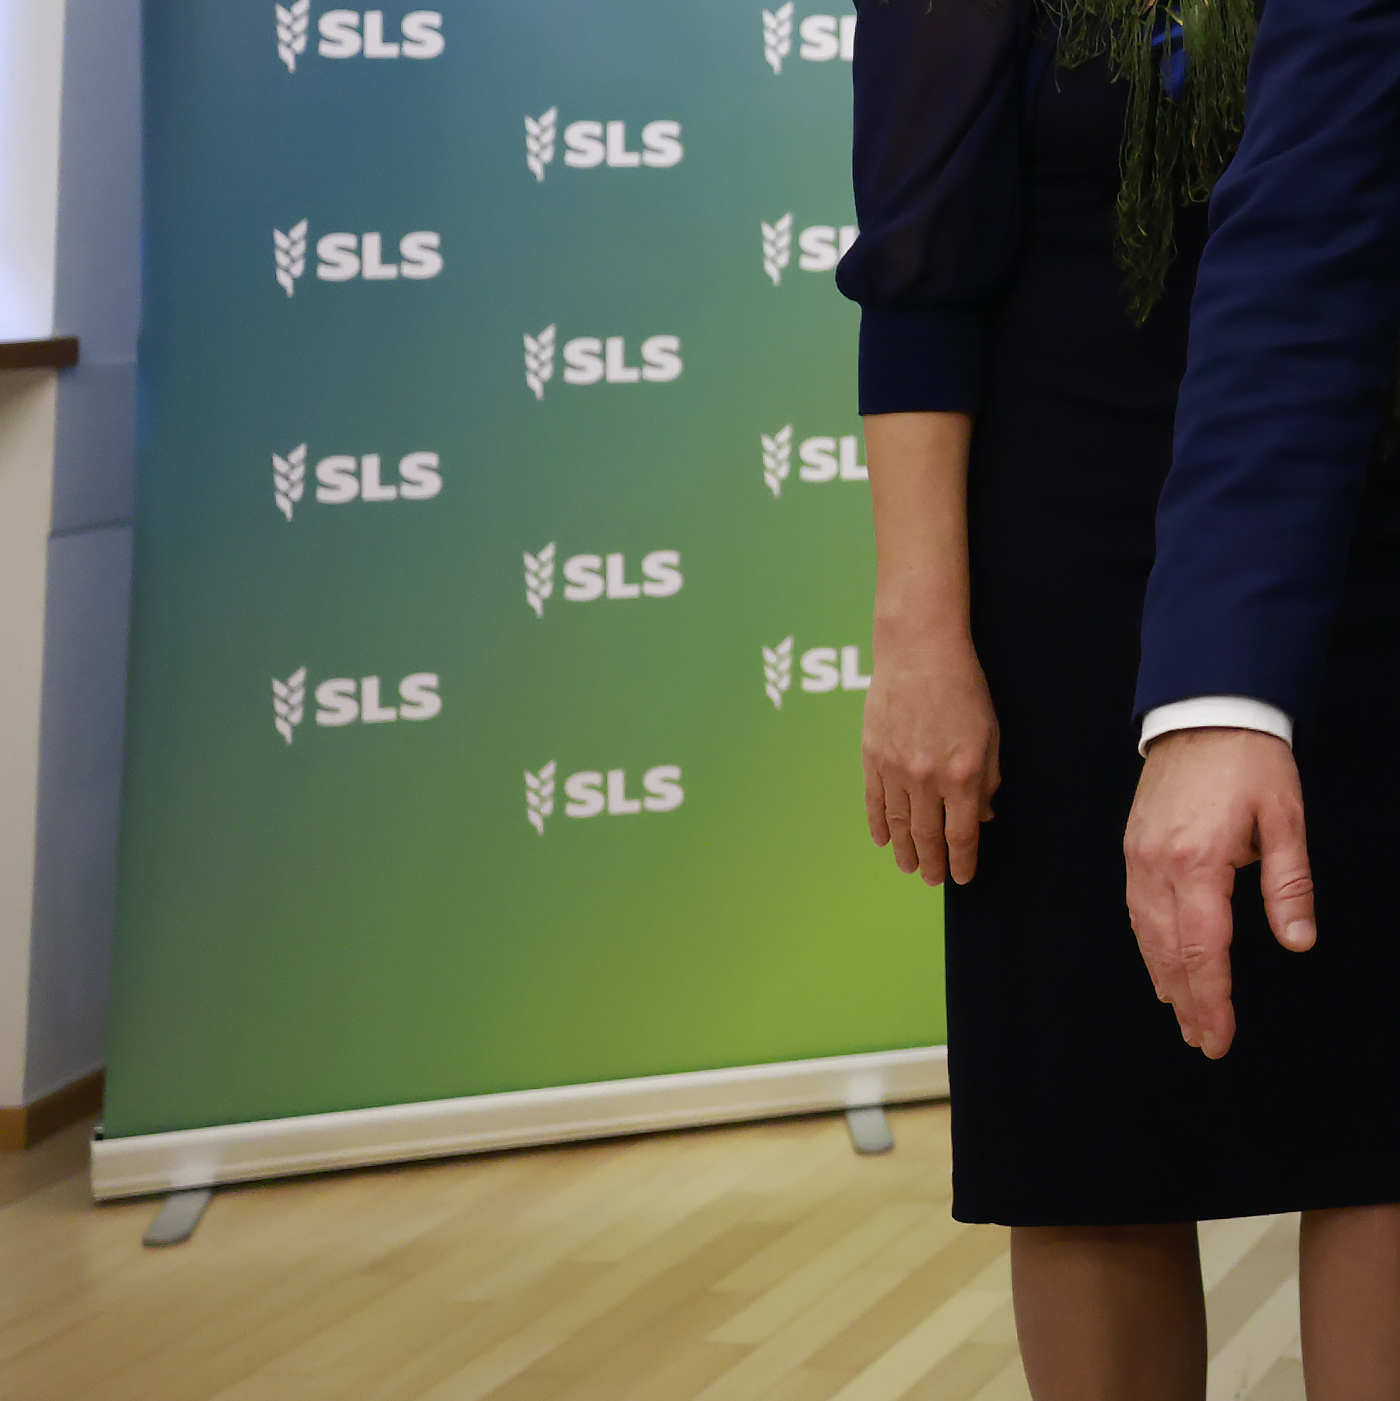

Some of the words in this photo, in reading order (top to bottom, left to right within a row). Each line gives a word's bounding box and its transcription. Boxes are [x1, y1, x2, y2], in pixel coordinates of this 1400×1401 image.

[317, 9, 446, 60] SLS
[563, 119, 685, 170] SLS
[316, 230, 444, 282] SLS
[562, 334, 684, 386] SLS
[315, 451, 443, 504] SLS
[799, 435, 871, 483] SL
[562, 548, 685, 603] SLS
[800, 645, 873, 693] SL
[314, 672, 443, 727] SLS
[564, 764, 685, 819] SLS
